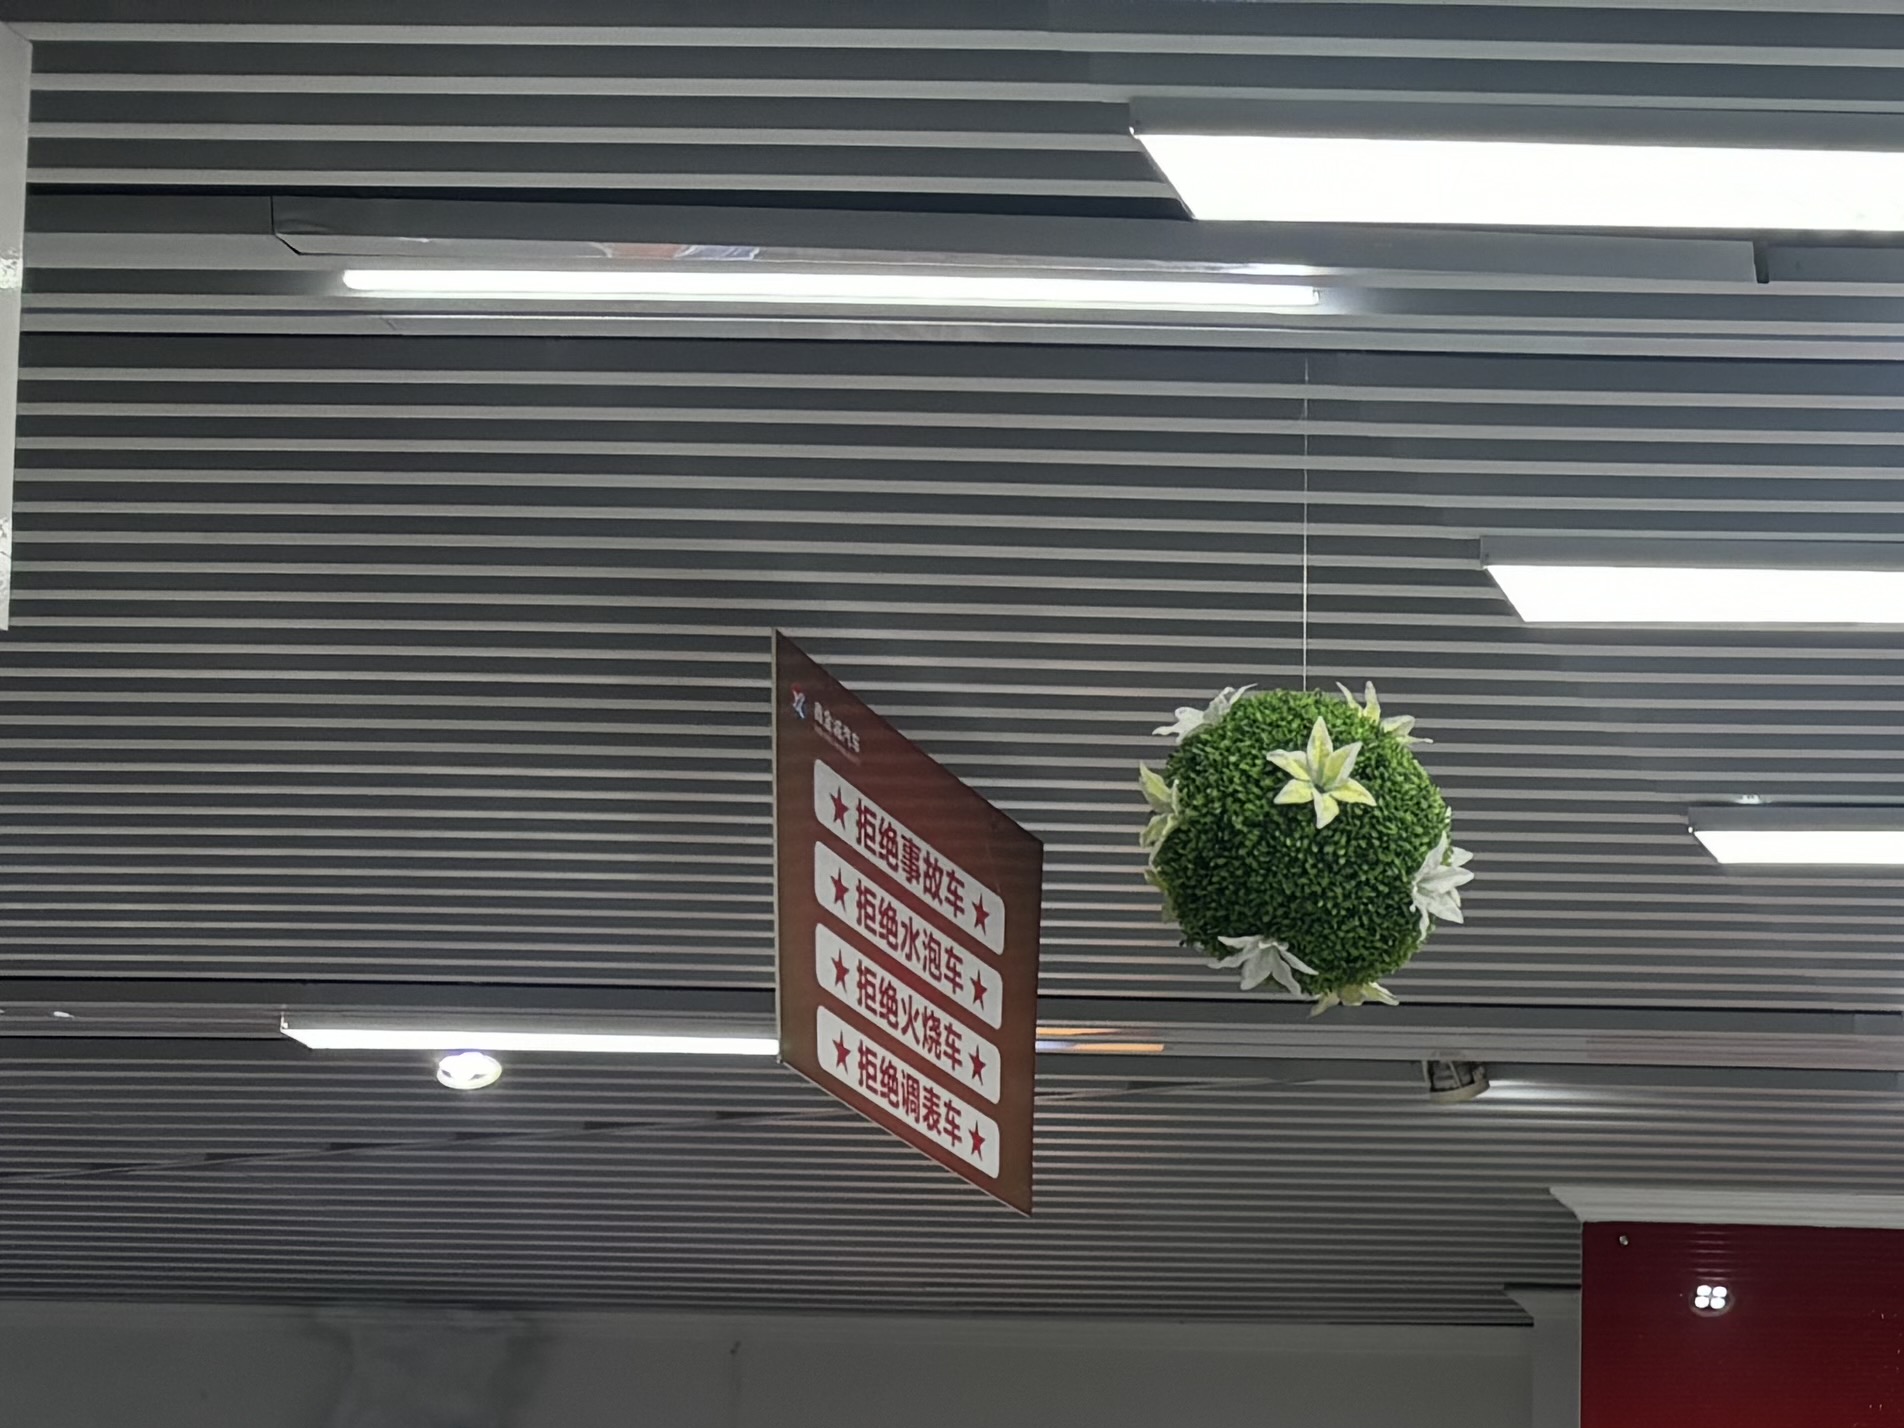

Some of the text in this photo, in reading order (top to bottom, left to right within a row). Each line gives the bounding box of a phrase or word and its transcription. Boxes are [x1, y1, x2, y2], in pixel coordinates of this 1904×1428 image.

[856, 798, 965, 919] 拒绝事故车
[856, 880, 965, 996] 拒绝水泡车
[856, 959, 964, 1073] 拒绝火烧车
[857, 1040, 963, 1148] 拒绝调表车
